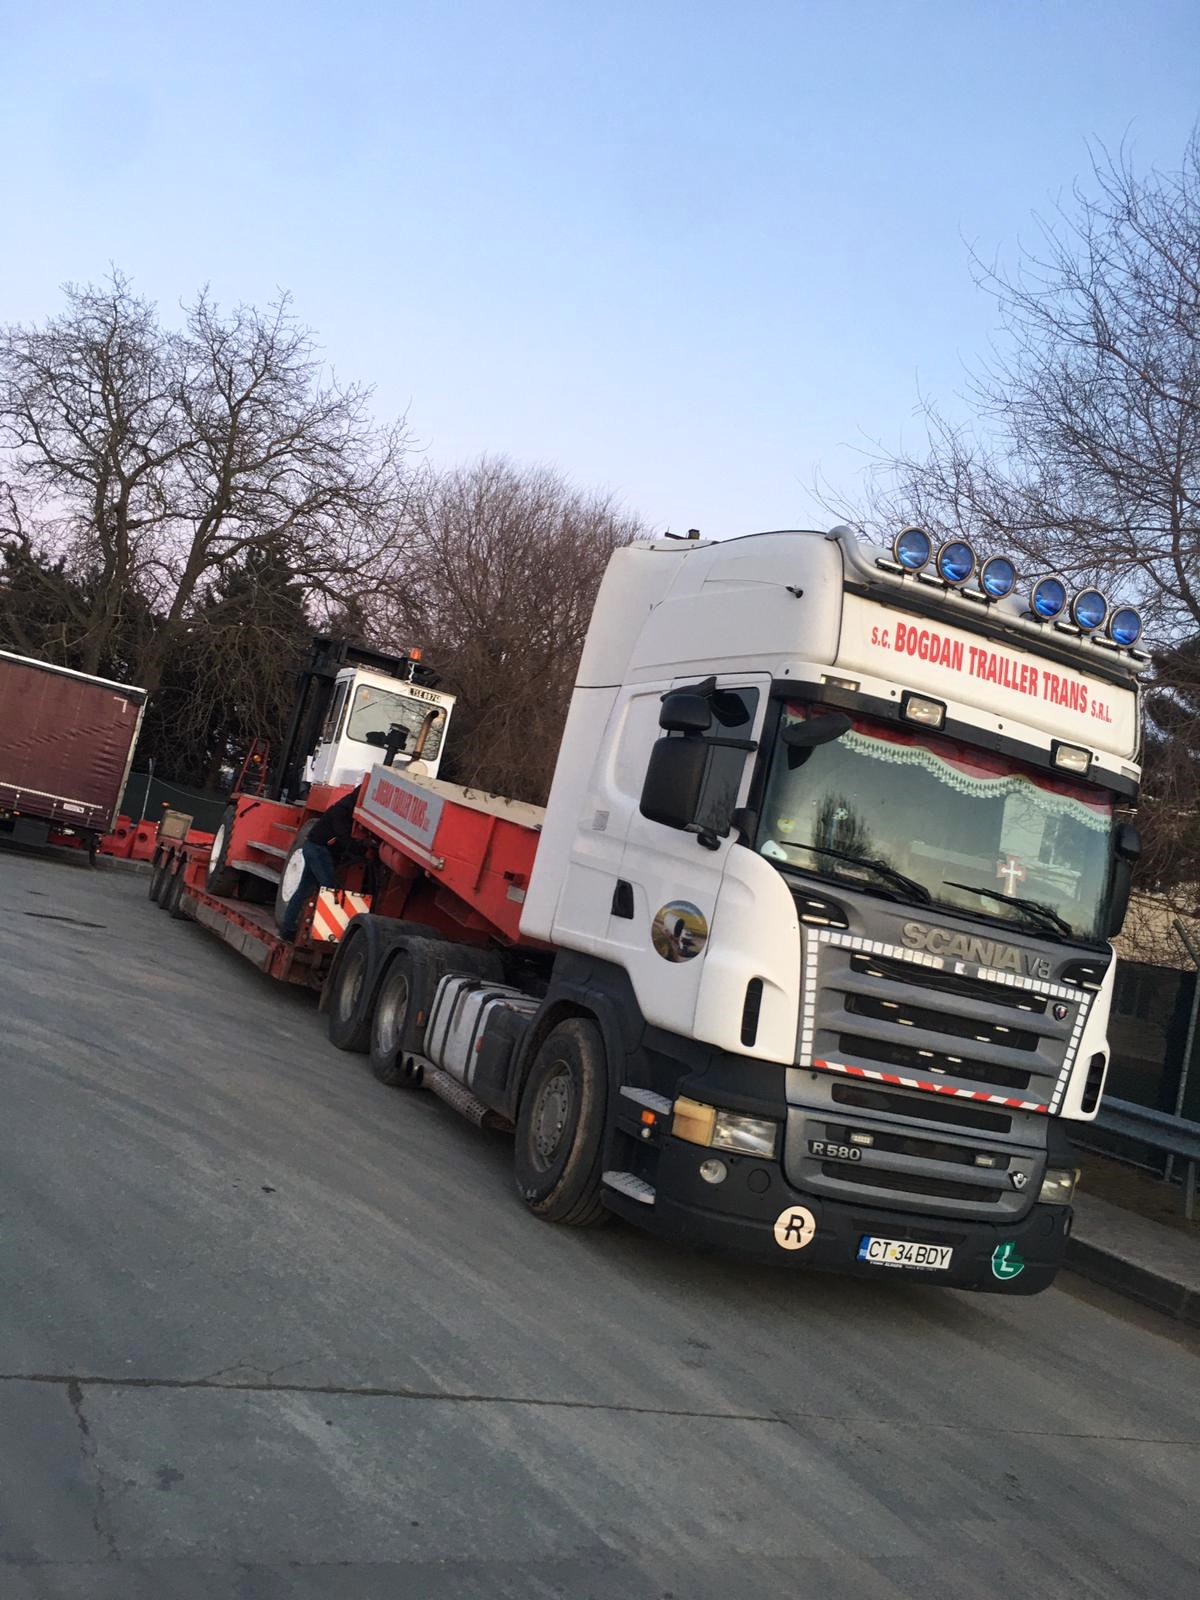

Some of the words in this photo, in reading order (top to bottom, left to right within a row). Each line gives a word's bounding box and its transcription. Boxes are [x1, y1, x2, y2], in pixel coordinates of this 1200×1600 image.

[871, 626, 891, 650] S.C.
[894, 622, 964, 672] BOGDAN
[968, 646, 1039, 698] TRAILLER
[1042, 671, 1088, 714] TRANS
[1090, 699, 1112, 724] S.R.L.
[901, 921, 1023, 975] SCANIA
[1025, 954, 1051, 979] V8
[784, 1213, 805, 1243] R
